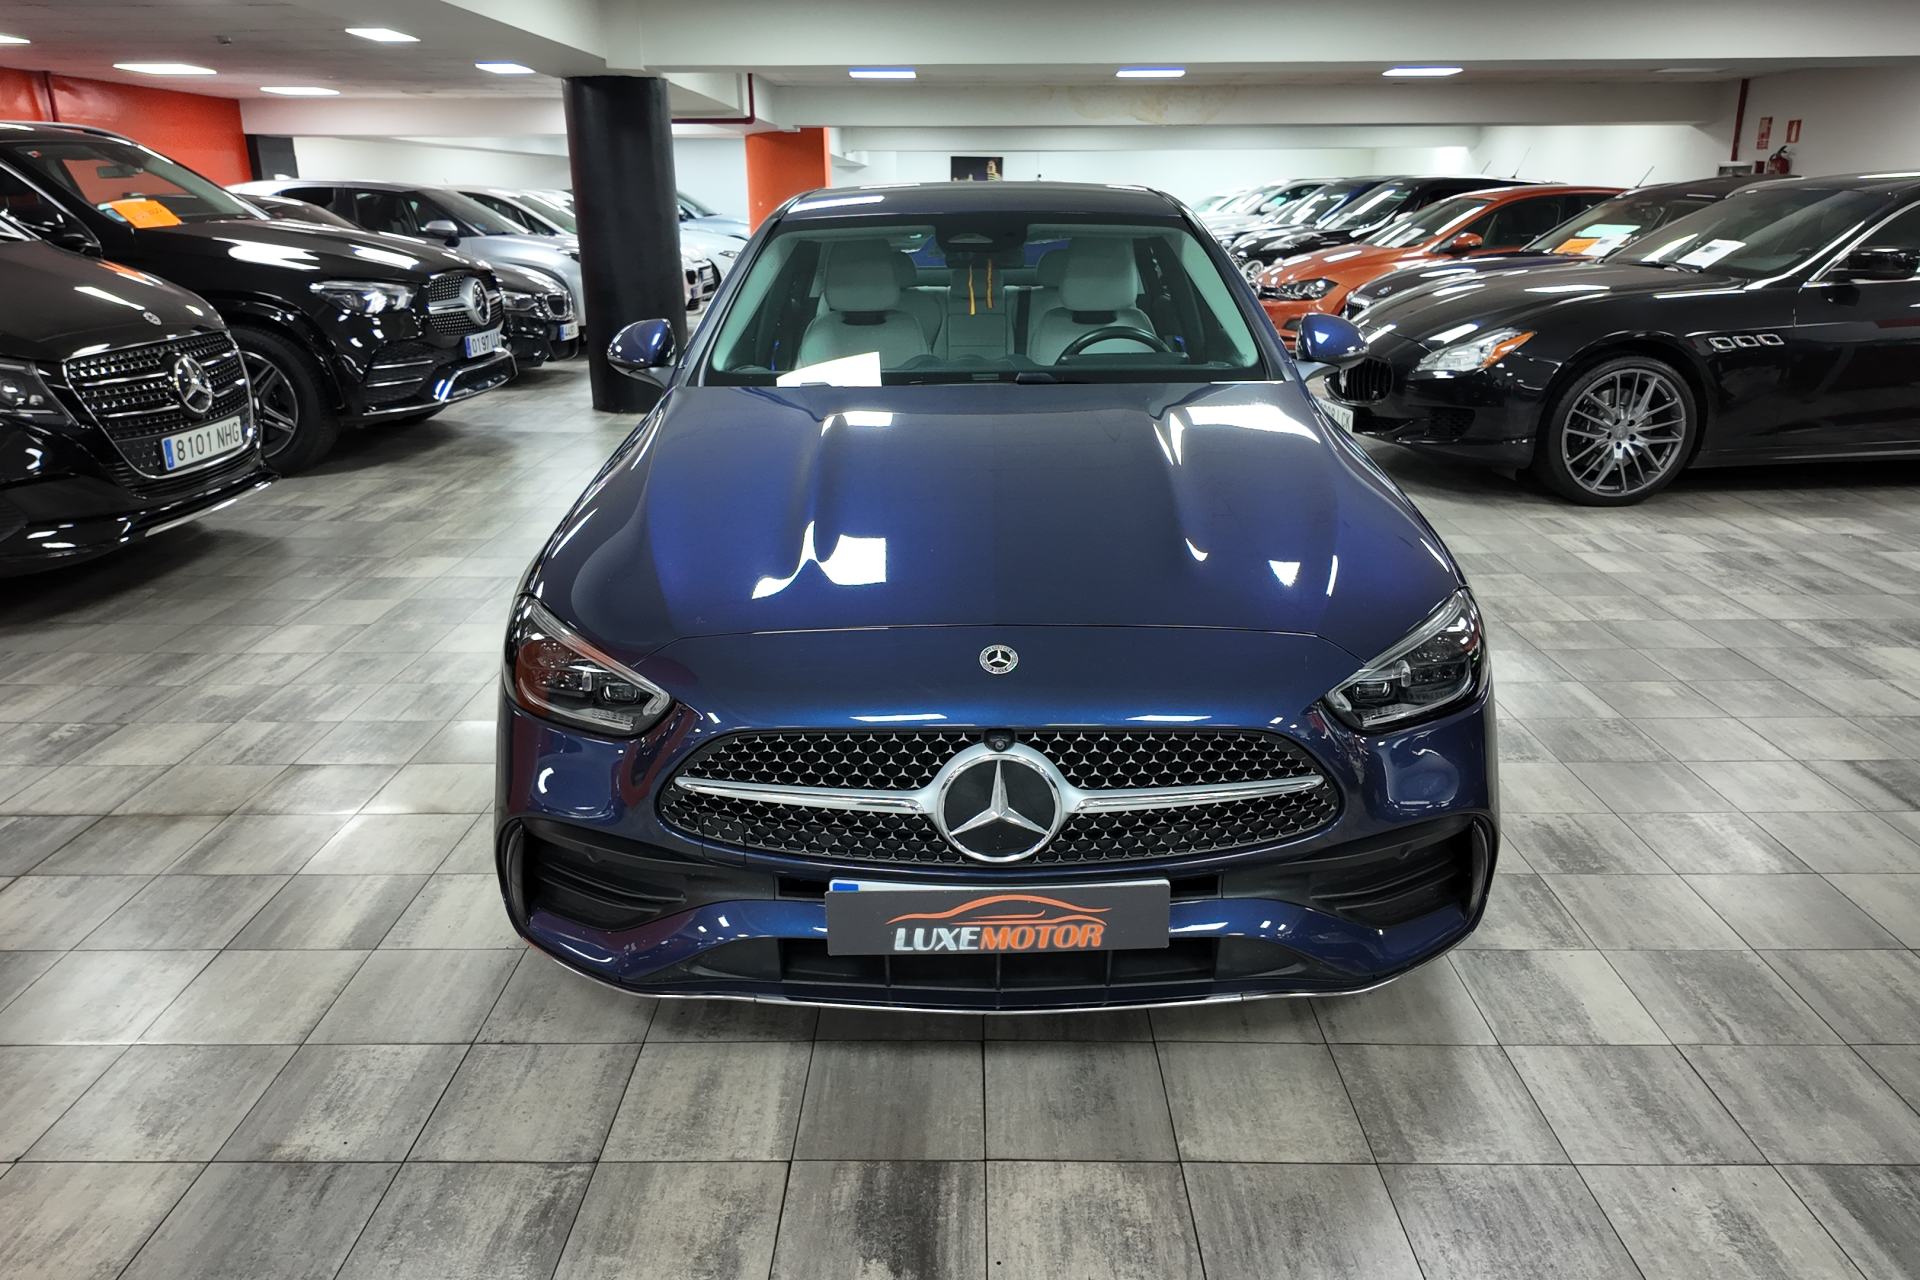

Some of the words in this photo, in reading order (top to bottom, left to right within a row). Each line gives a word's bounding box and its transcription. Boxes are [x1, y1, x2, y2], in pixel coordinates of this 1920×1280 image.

[176, 431, 212, 461] 8101
[216, 422, 239, 449] NHG
[894, 924, 1105, 951] LUXEMOTOR
